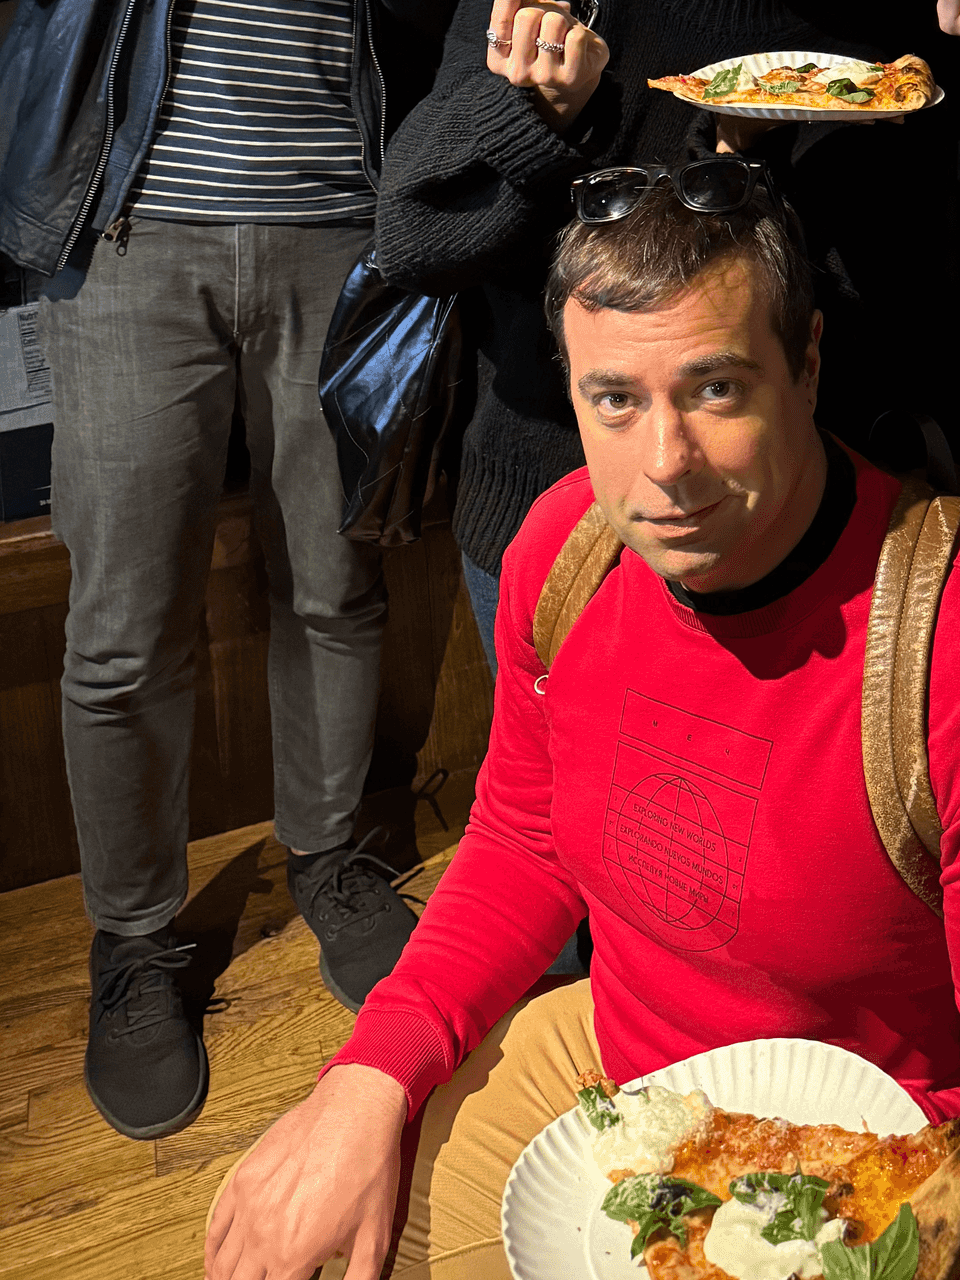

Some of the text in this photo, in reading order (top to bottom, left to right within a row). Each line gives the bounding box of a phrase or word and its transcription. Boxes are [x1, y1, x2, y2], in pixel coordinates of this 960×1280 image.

[620, 824, 724, 885] EXPLORANDO NUEVOS MUNDOS
[633, 803, 717, 852] EXPLORING NEW WORLDS
